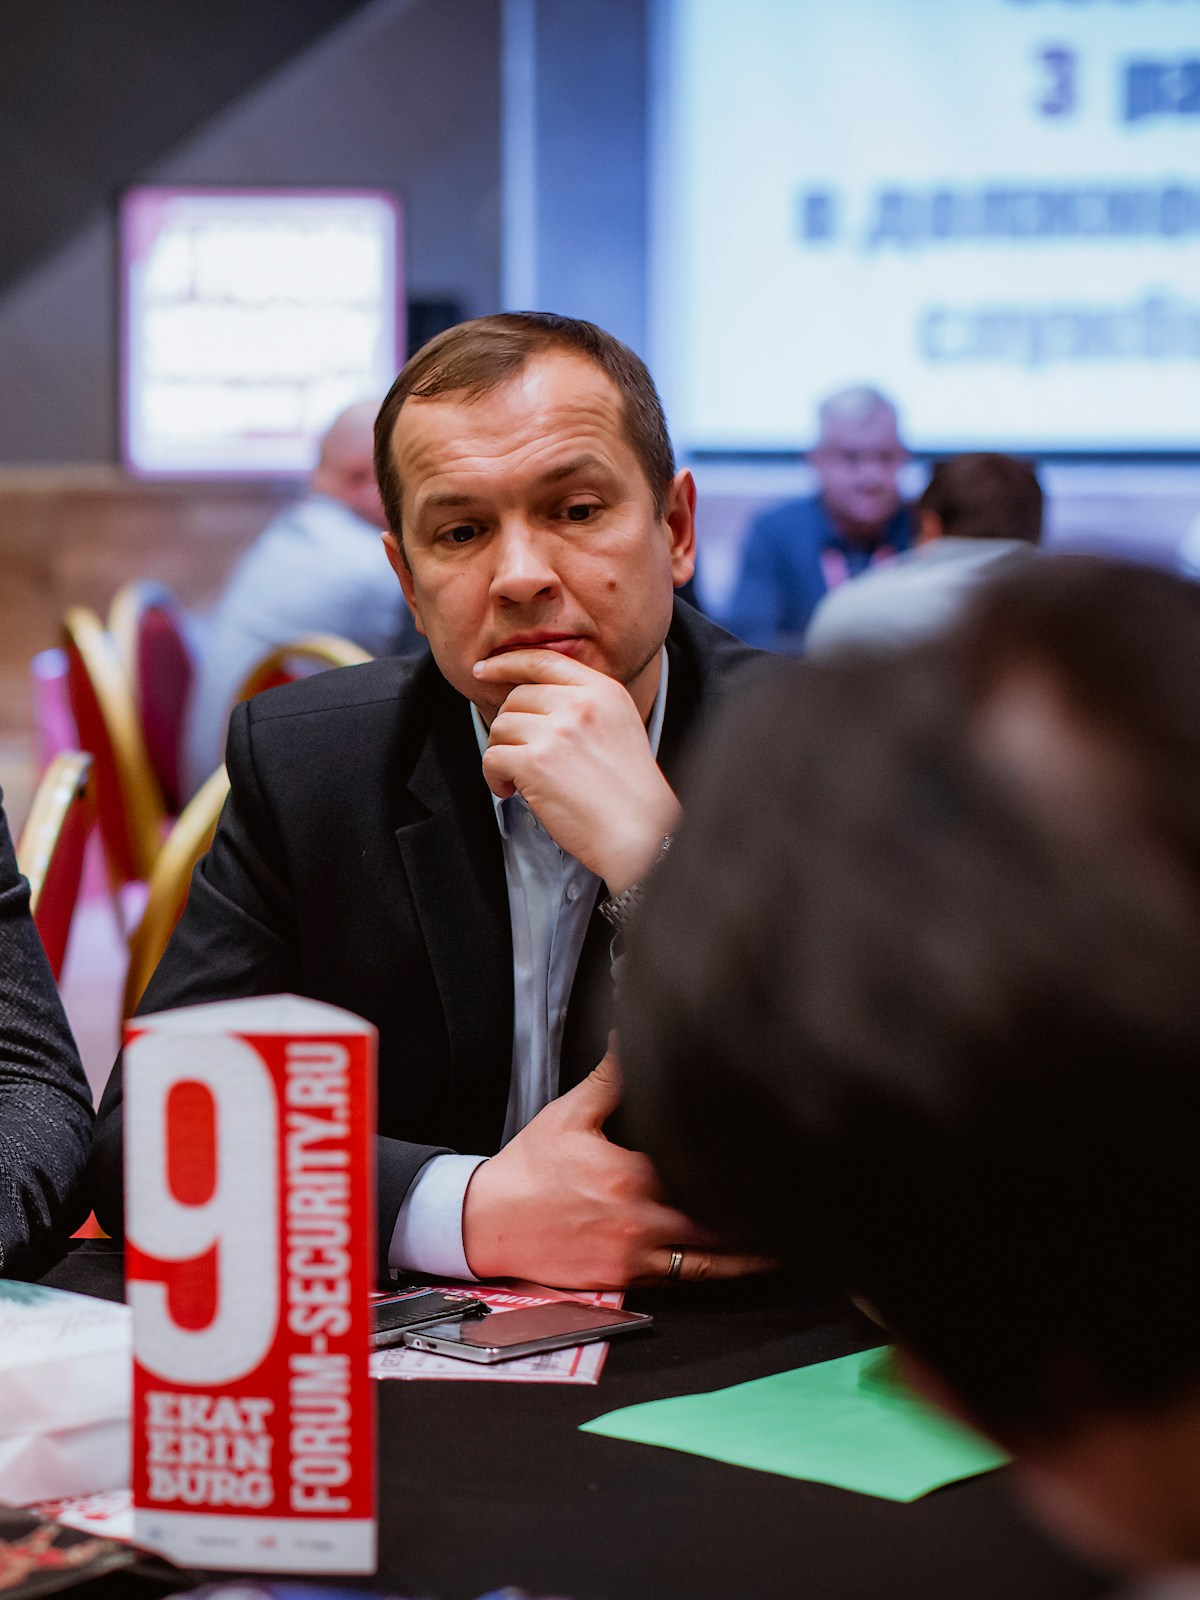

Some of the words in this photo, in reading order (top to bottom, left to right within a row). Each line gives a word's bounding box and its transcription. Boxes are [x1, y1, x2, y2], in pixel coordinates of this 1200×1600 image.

[918, 288, 1200, 368] служб
[125, 1029, 279, 1386] 9
[286, 1041, 351, 1513] FORUM-SECURITY.RU
[145, 1391, 273, 1432] EKAT
[146, 1430, 274, 1469] ERIN
[147, 1466, 274, 1508] BURG
